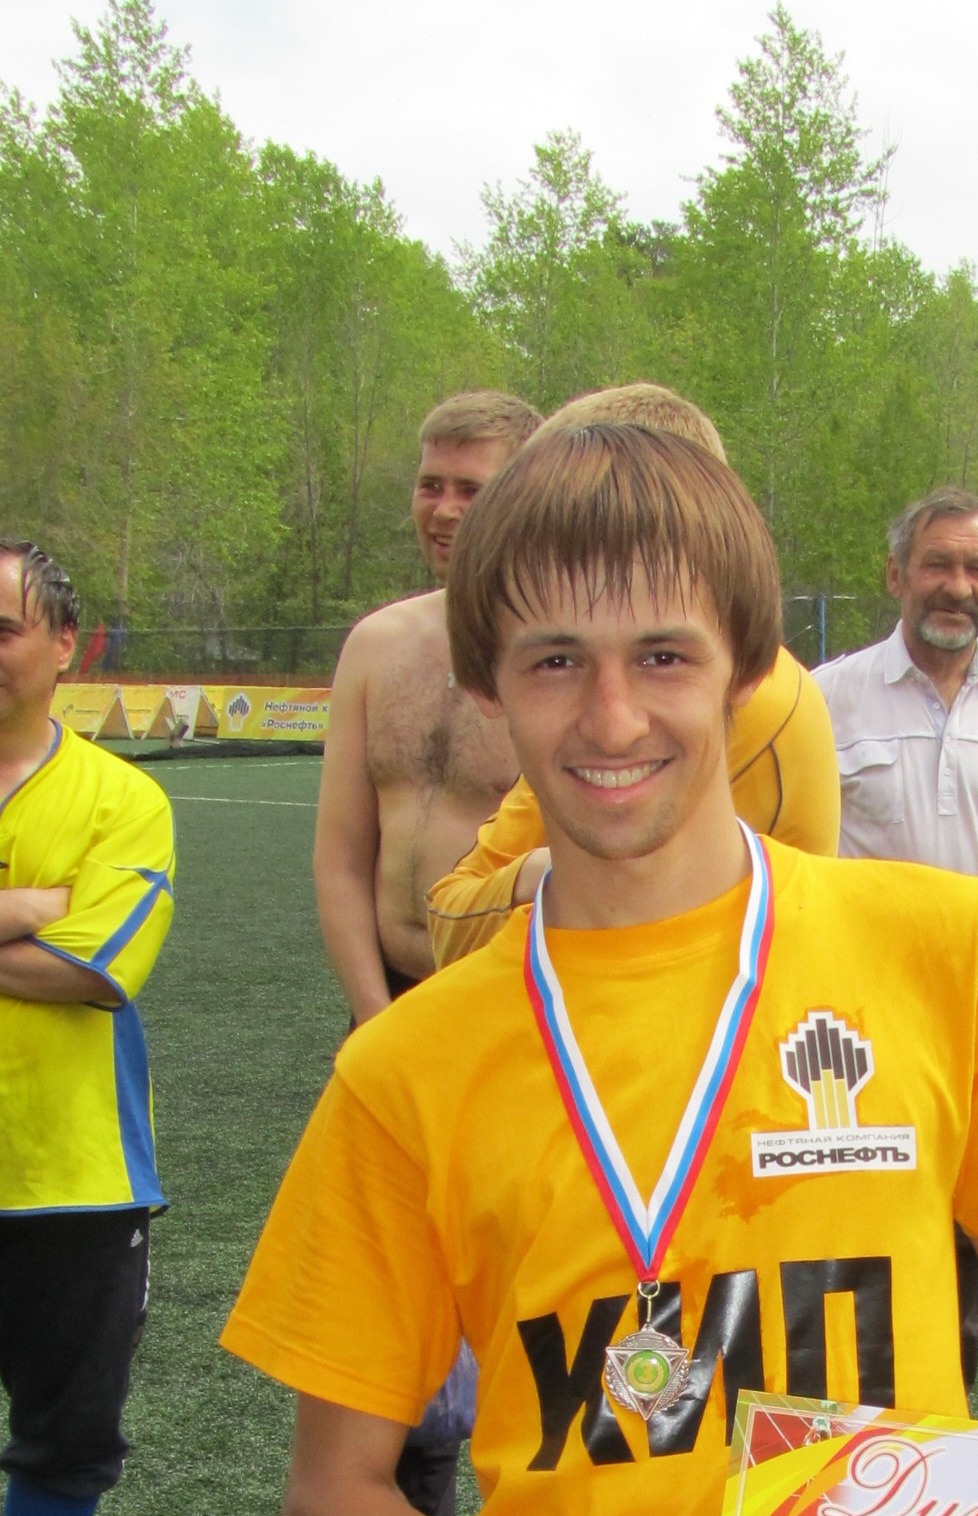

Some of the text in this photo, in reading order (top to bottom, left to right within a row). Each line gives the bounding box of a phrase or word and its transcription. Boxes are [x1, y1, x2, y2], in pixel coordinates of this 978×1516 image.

[757, 1133, 910, 1147] НЕФТЯНАЯ КОМПАНИЯ
[758, 1146, 911, 1170] РОСНЕФТЬ
